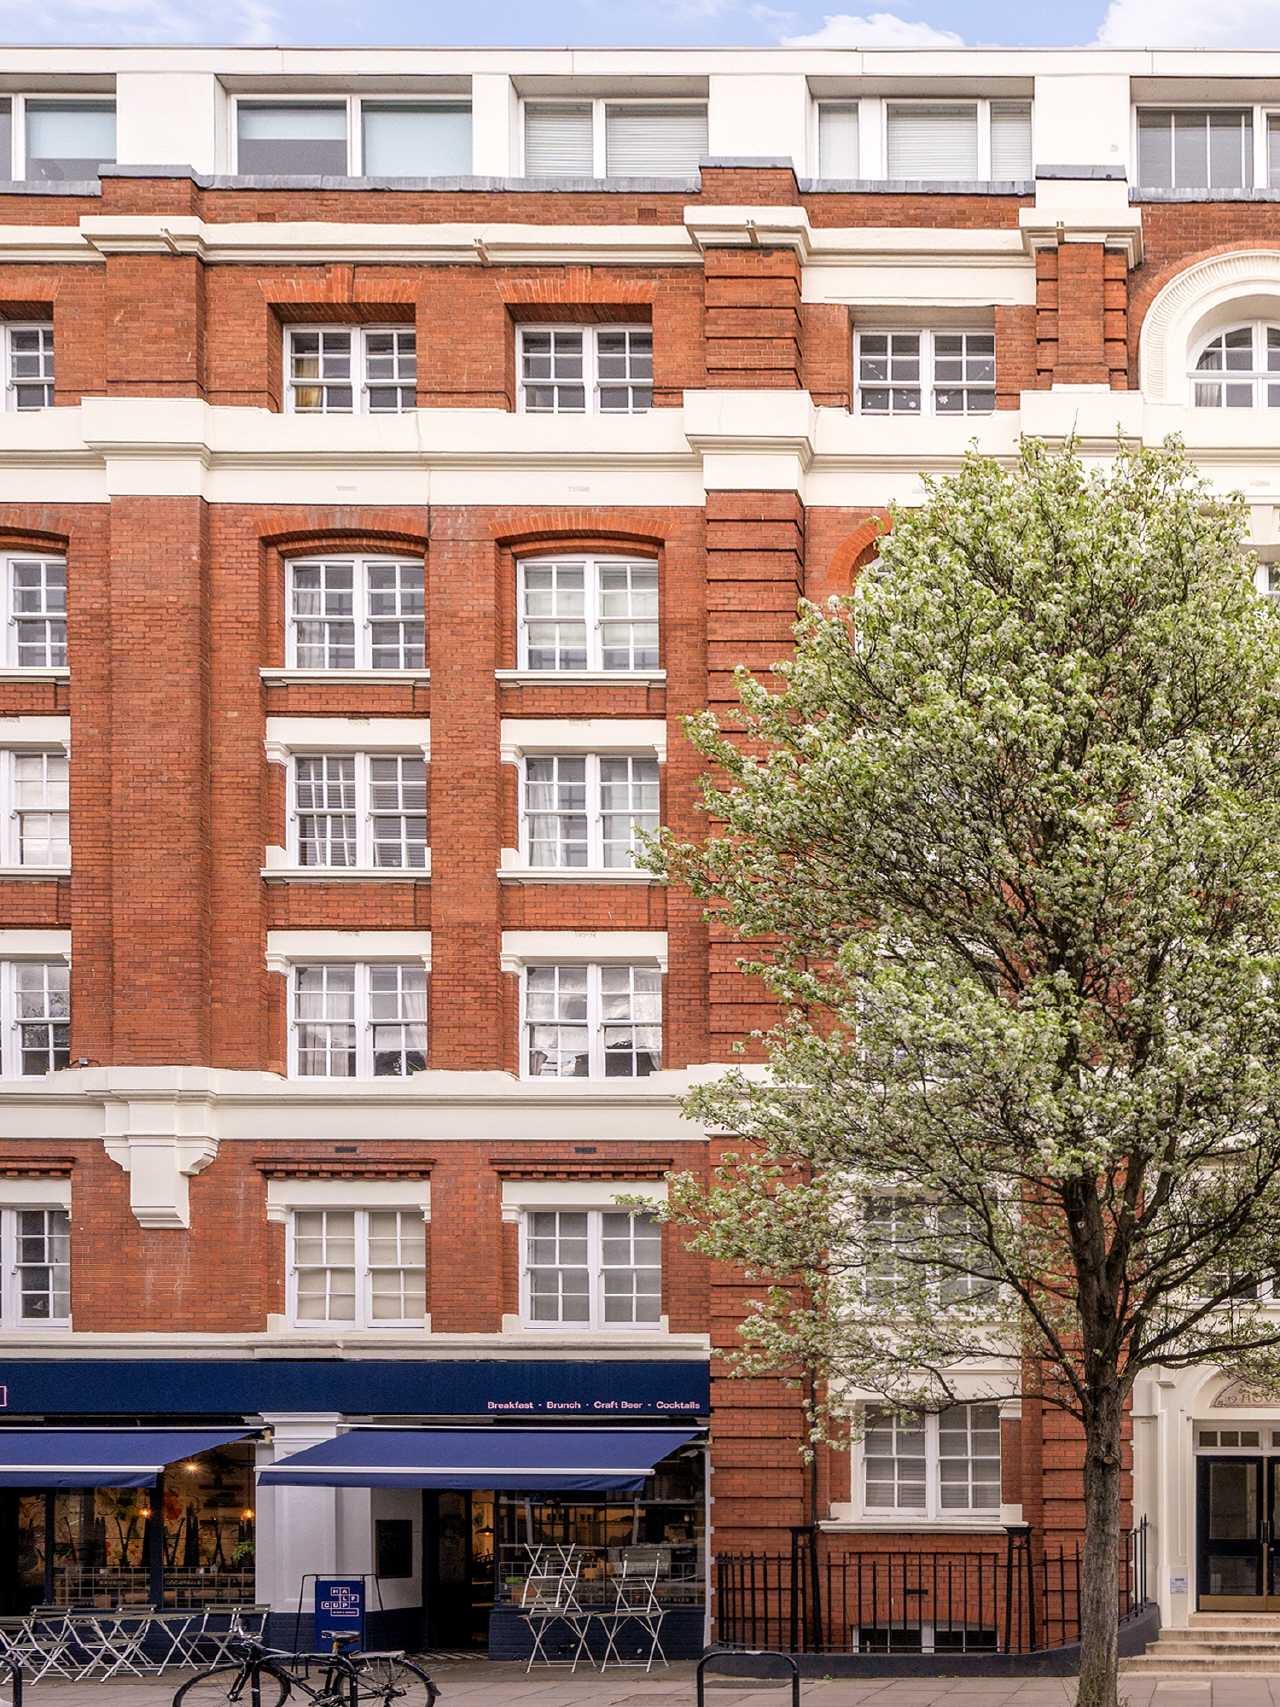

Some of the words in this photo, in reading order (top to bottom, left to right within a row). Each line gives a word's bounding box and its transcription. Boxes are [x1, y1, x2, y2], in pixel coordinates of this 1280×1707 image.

[487, 1401, 534, 1410] Breakfast
[546, 1401, 581, 1410] Brunch
[593, 1401, 619, 1410] Craft
[621, 1401, 643, 1410] Beer
[656, 1401, 701, 1410] Cocktails
